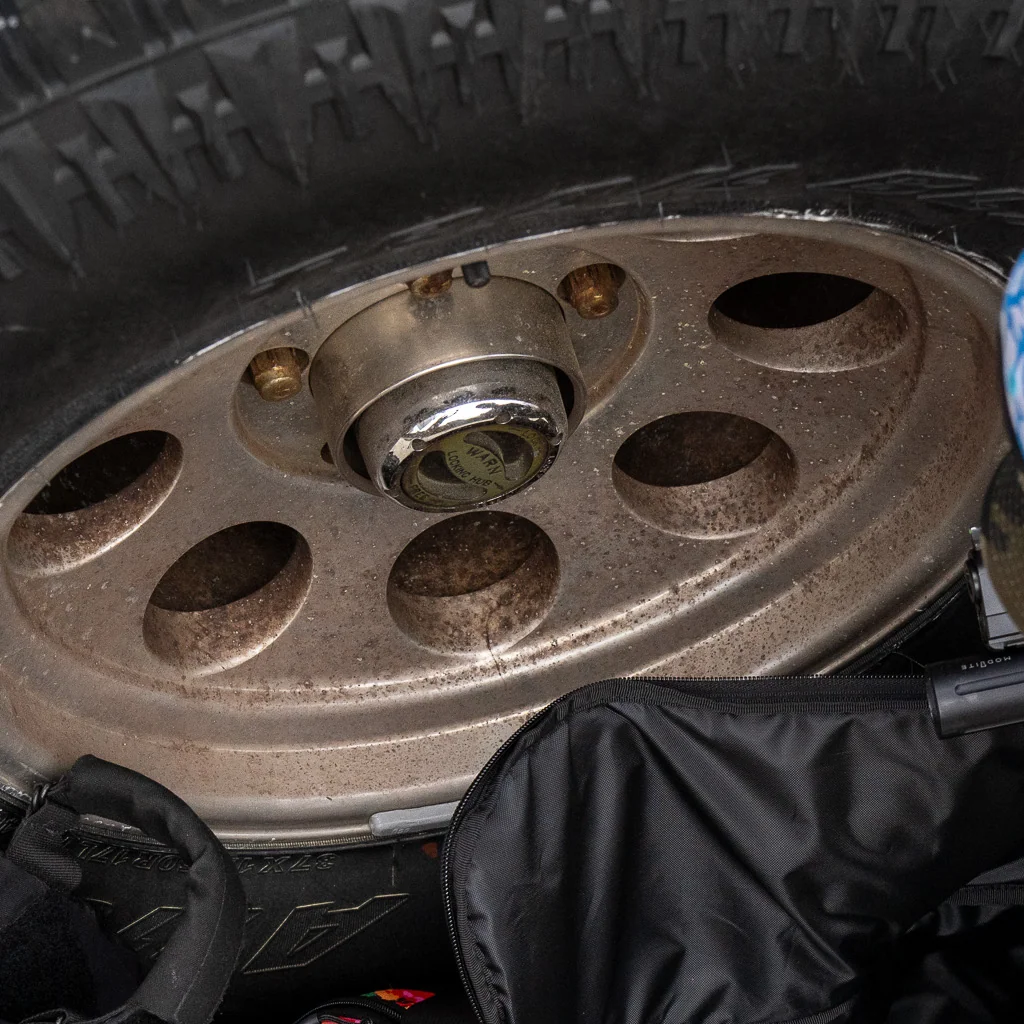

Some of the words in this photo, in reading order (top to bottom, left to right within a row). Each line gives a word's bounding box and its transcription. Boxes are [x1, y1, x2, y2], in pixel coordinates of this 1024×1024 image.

[447, 450, 471, 478] LOCKING
[470, 474, 491, 486] HUB
[466, 446, 502, 475] WARN
